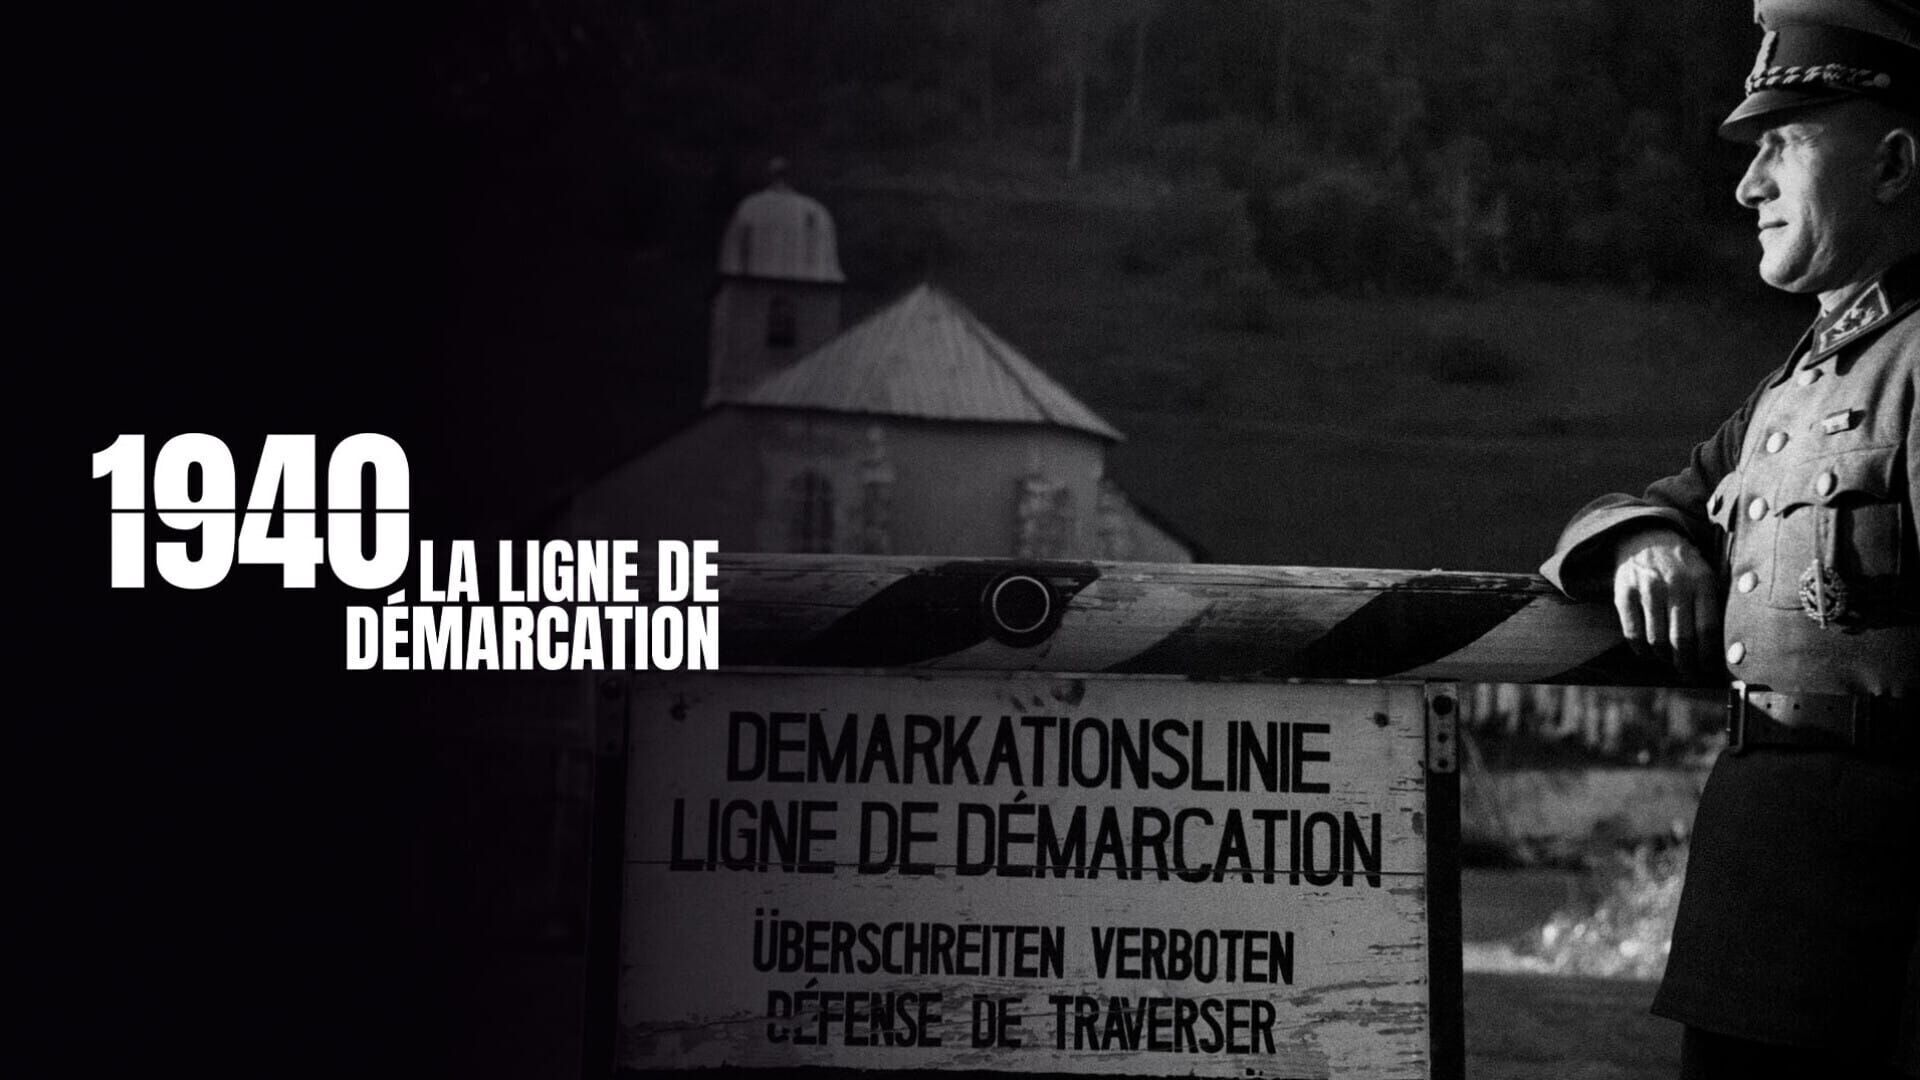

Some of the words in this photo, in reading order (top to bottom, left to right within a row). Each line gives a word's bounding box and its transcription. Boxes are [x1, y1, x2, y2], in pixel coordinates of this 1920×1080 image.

[726, 711, 1331, 793] DEMARKATIONSLINIE
[669, 798, 836, 873] LIGNE
[858, 801, 938, 875] DE
[955, 791, 1382, 887] DÉMARCATION
[753, 907, 1065, 979] ÜBERSCHREITEN
[1092, 927, 1294, 985] VERBOTEN
[767, 978, 942, 1048] DÉFENSE
[972, 994, 1022, 1048] DE
[1049, 995, 1277, 1054] TRAVERSER
